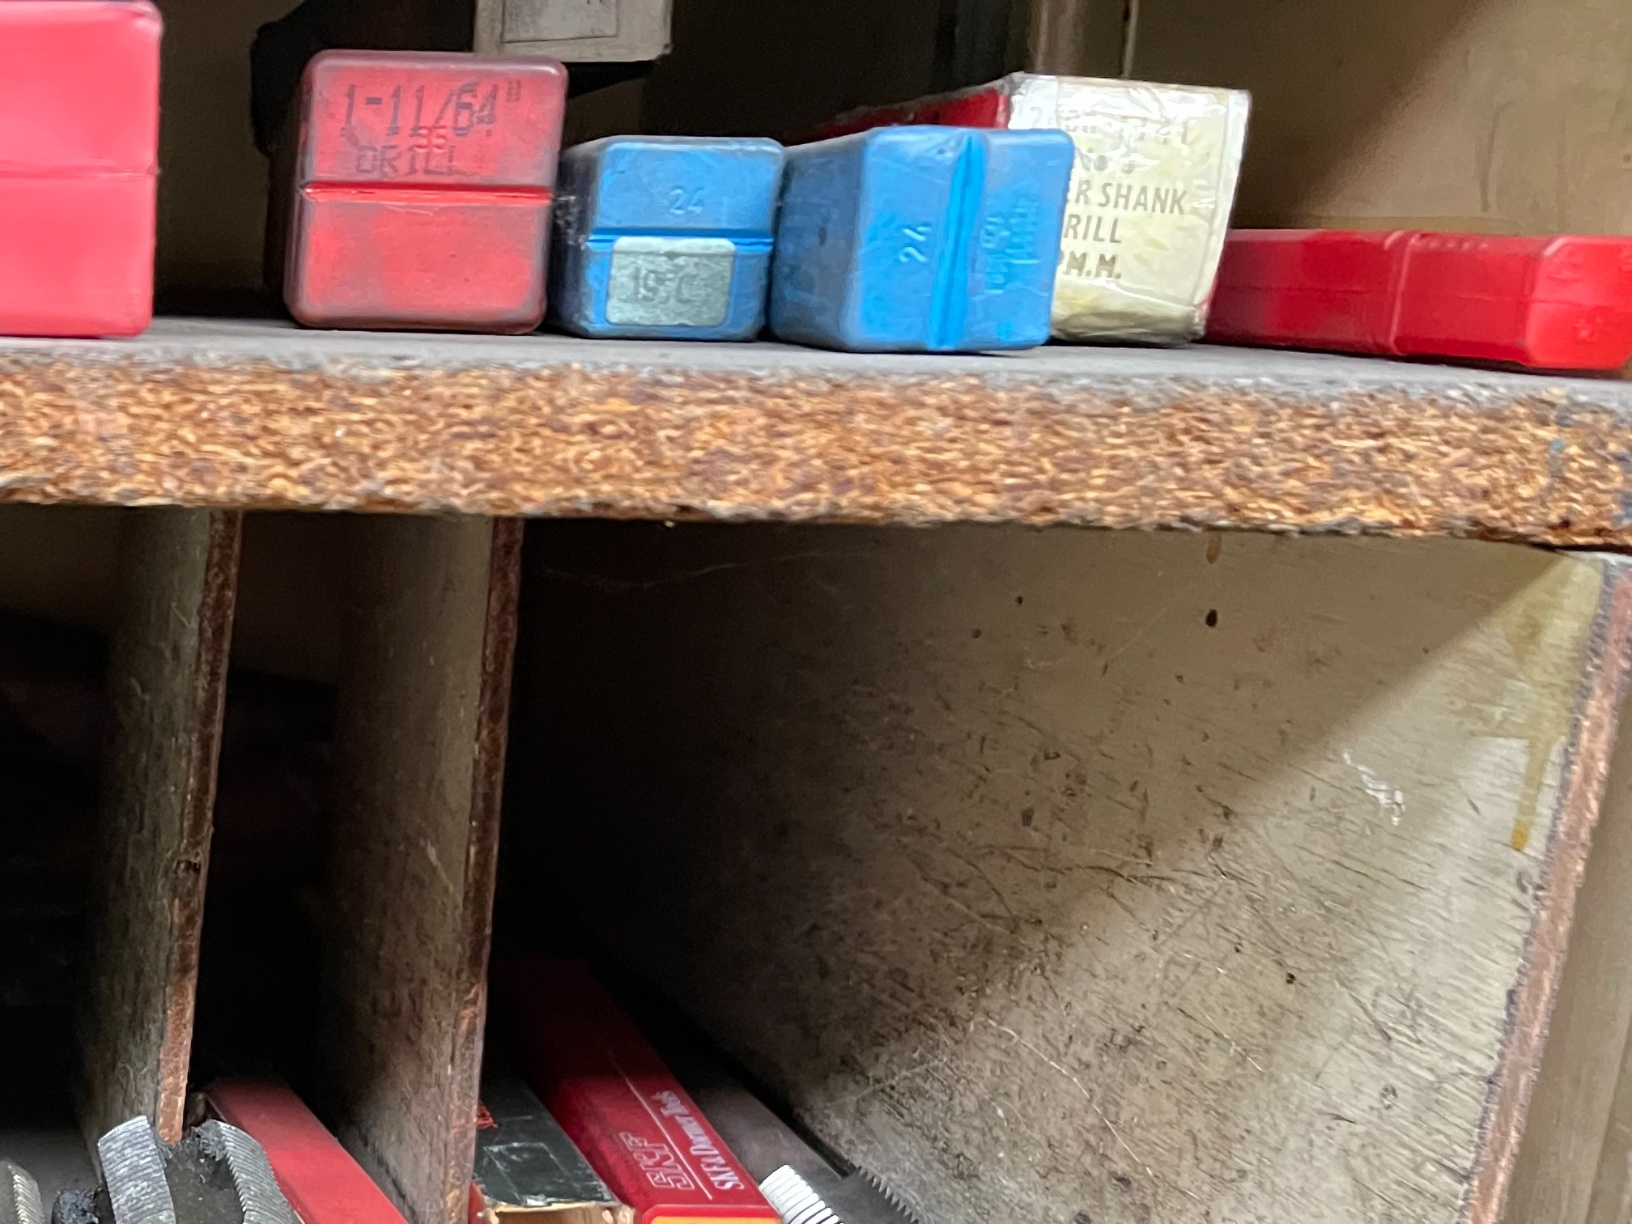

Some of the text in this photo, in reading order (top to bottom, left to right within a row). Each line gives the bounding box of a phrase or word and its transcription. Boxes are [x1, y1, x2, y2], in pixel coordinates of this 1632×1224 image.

[1097, 181, 1188, 216] SHANK
[1063, 213, 1122, 244] RILL
[1059, 250, 1123, 280] M.M.
